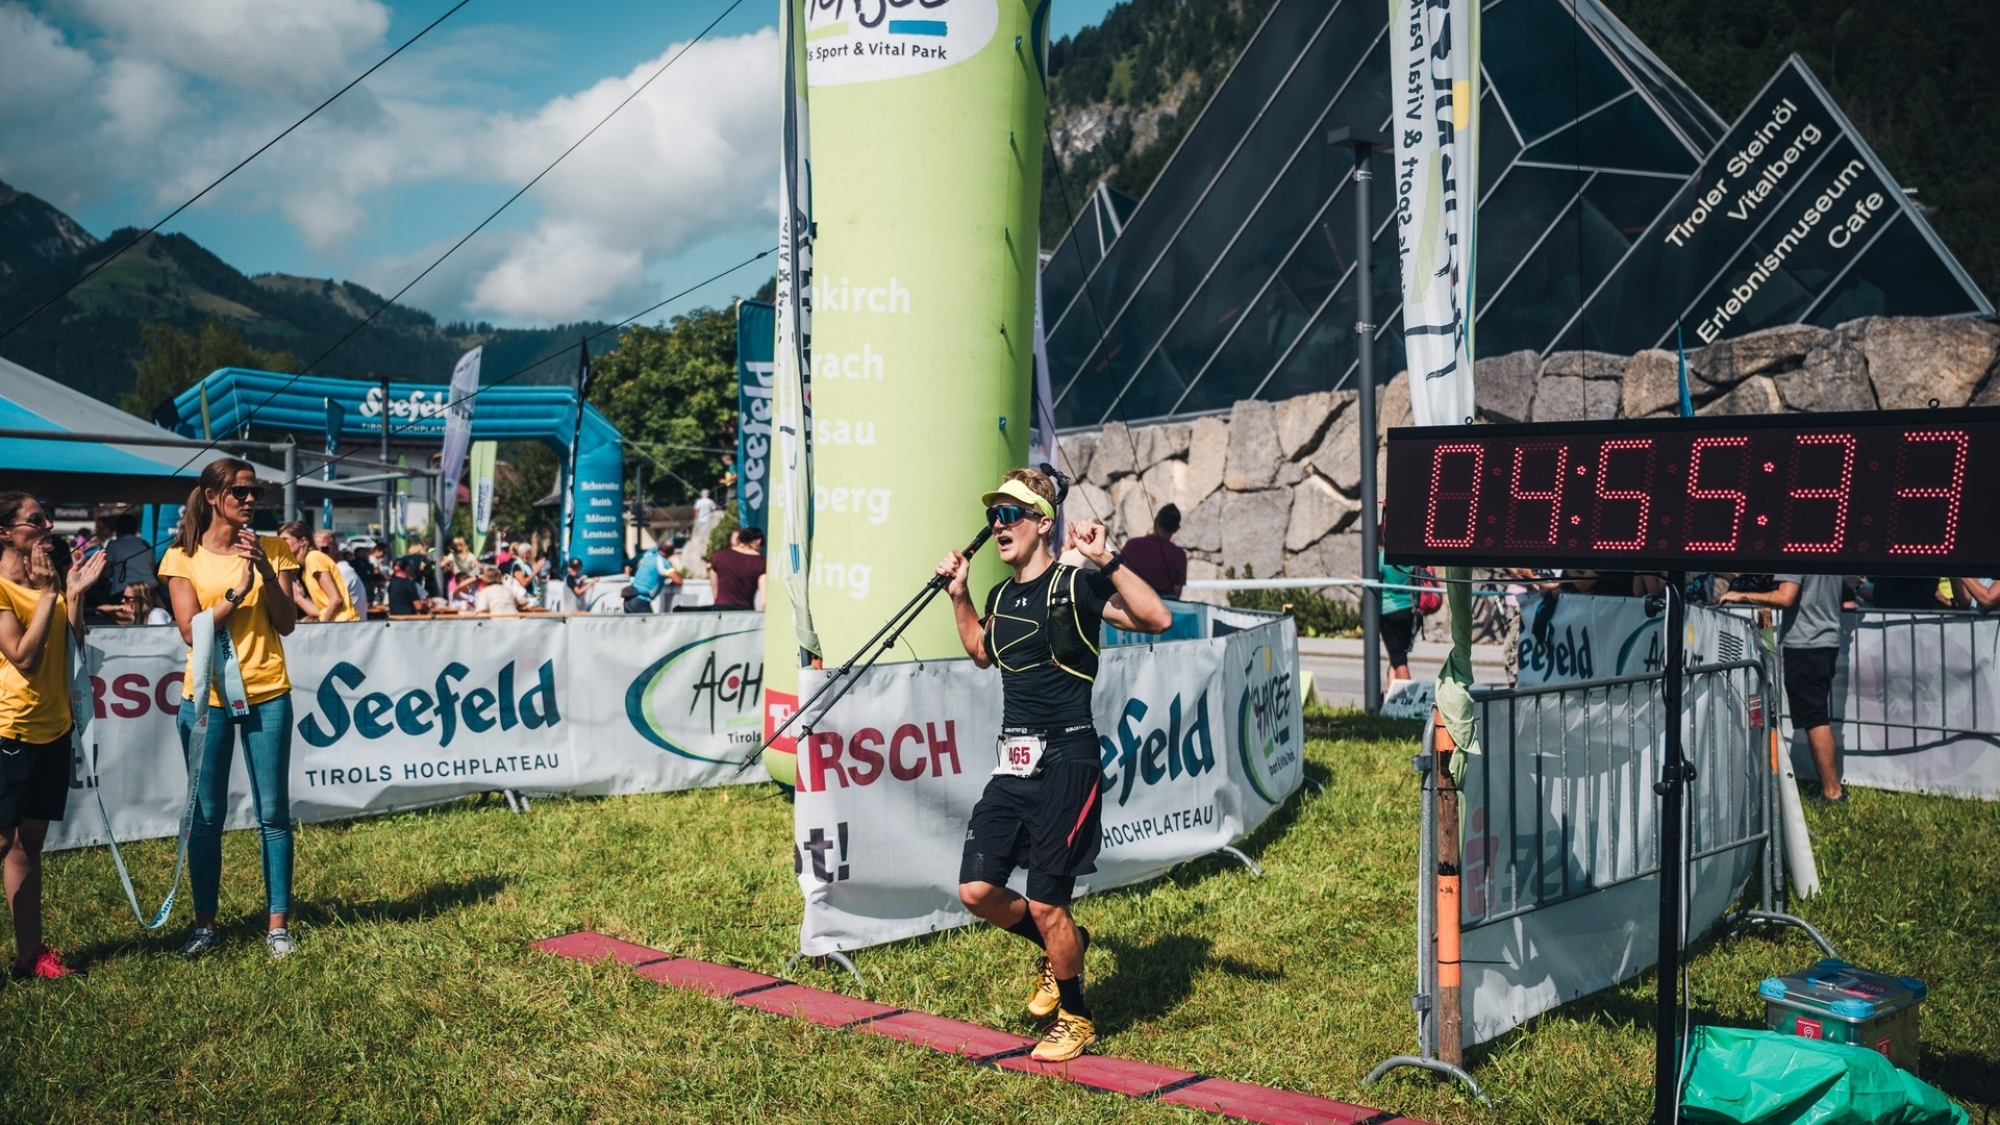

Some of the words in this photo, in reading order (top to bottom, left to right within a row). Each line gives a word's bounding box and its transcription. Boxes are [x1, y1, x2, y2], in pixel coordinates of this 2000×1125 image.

[816, 44, 848, 62] Sport
[854, 42, 864, 55] &
[869, 42, 905, 56] Vital
[912, 45, 947, 60] Park
[1664, 178, 1728, 248] Tiroler
[1726, 98, 1798, 179] Steinöl
[1727, 122, 1822, 223] Vitalberg
[1828, 192, 1884, 249] Cafe
[1696, 158, 1865, 344] Erlebnismuseum
[590, 498, 612, 507] Reith
[1425, 430, 1969, 554] 04:55:33
[582, 529, 619, 539] Leutasch
[587, 546, 615, 555] Seefeld
[1519, 618, 1594, 682] eefeld
[297, 658, 561, 748] Seefeld
[728, 732, 761, 744] Tirols
[796, 719, 961, 792] RSCH
[305, 765, 392, 788] TIROLS
[403, 752, 560, 780] HOCHPLATEAU
[795, 822, 850, 883] t!
[1101, 805, 1213, 849] HOCHPLATEAU
